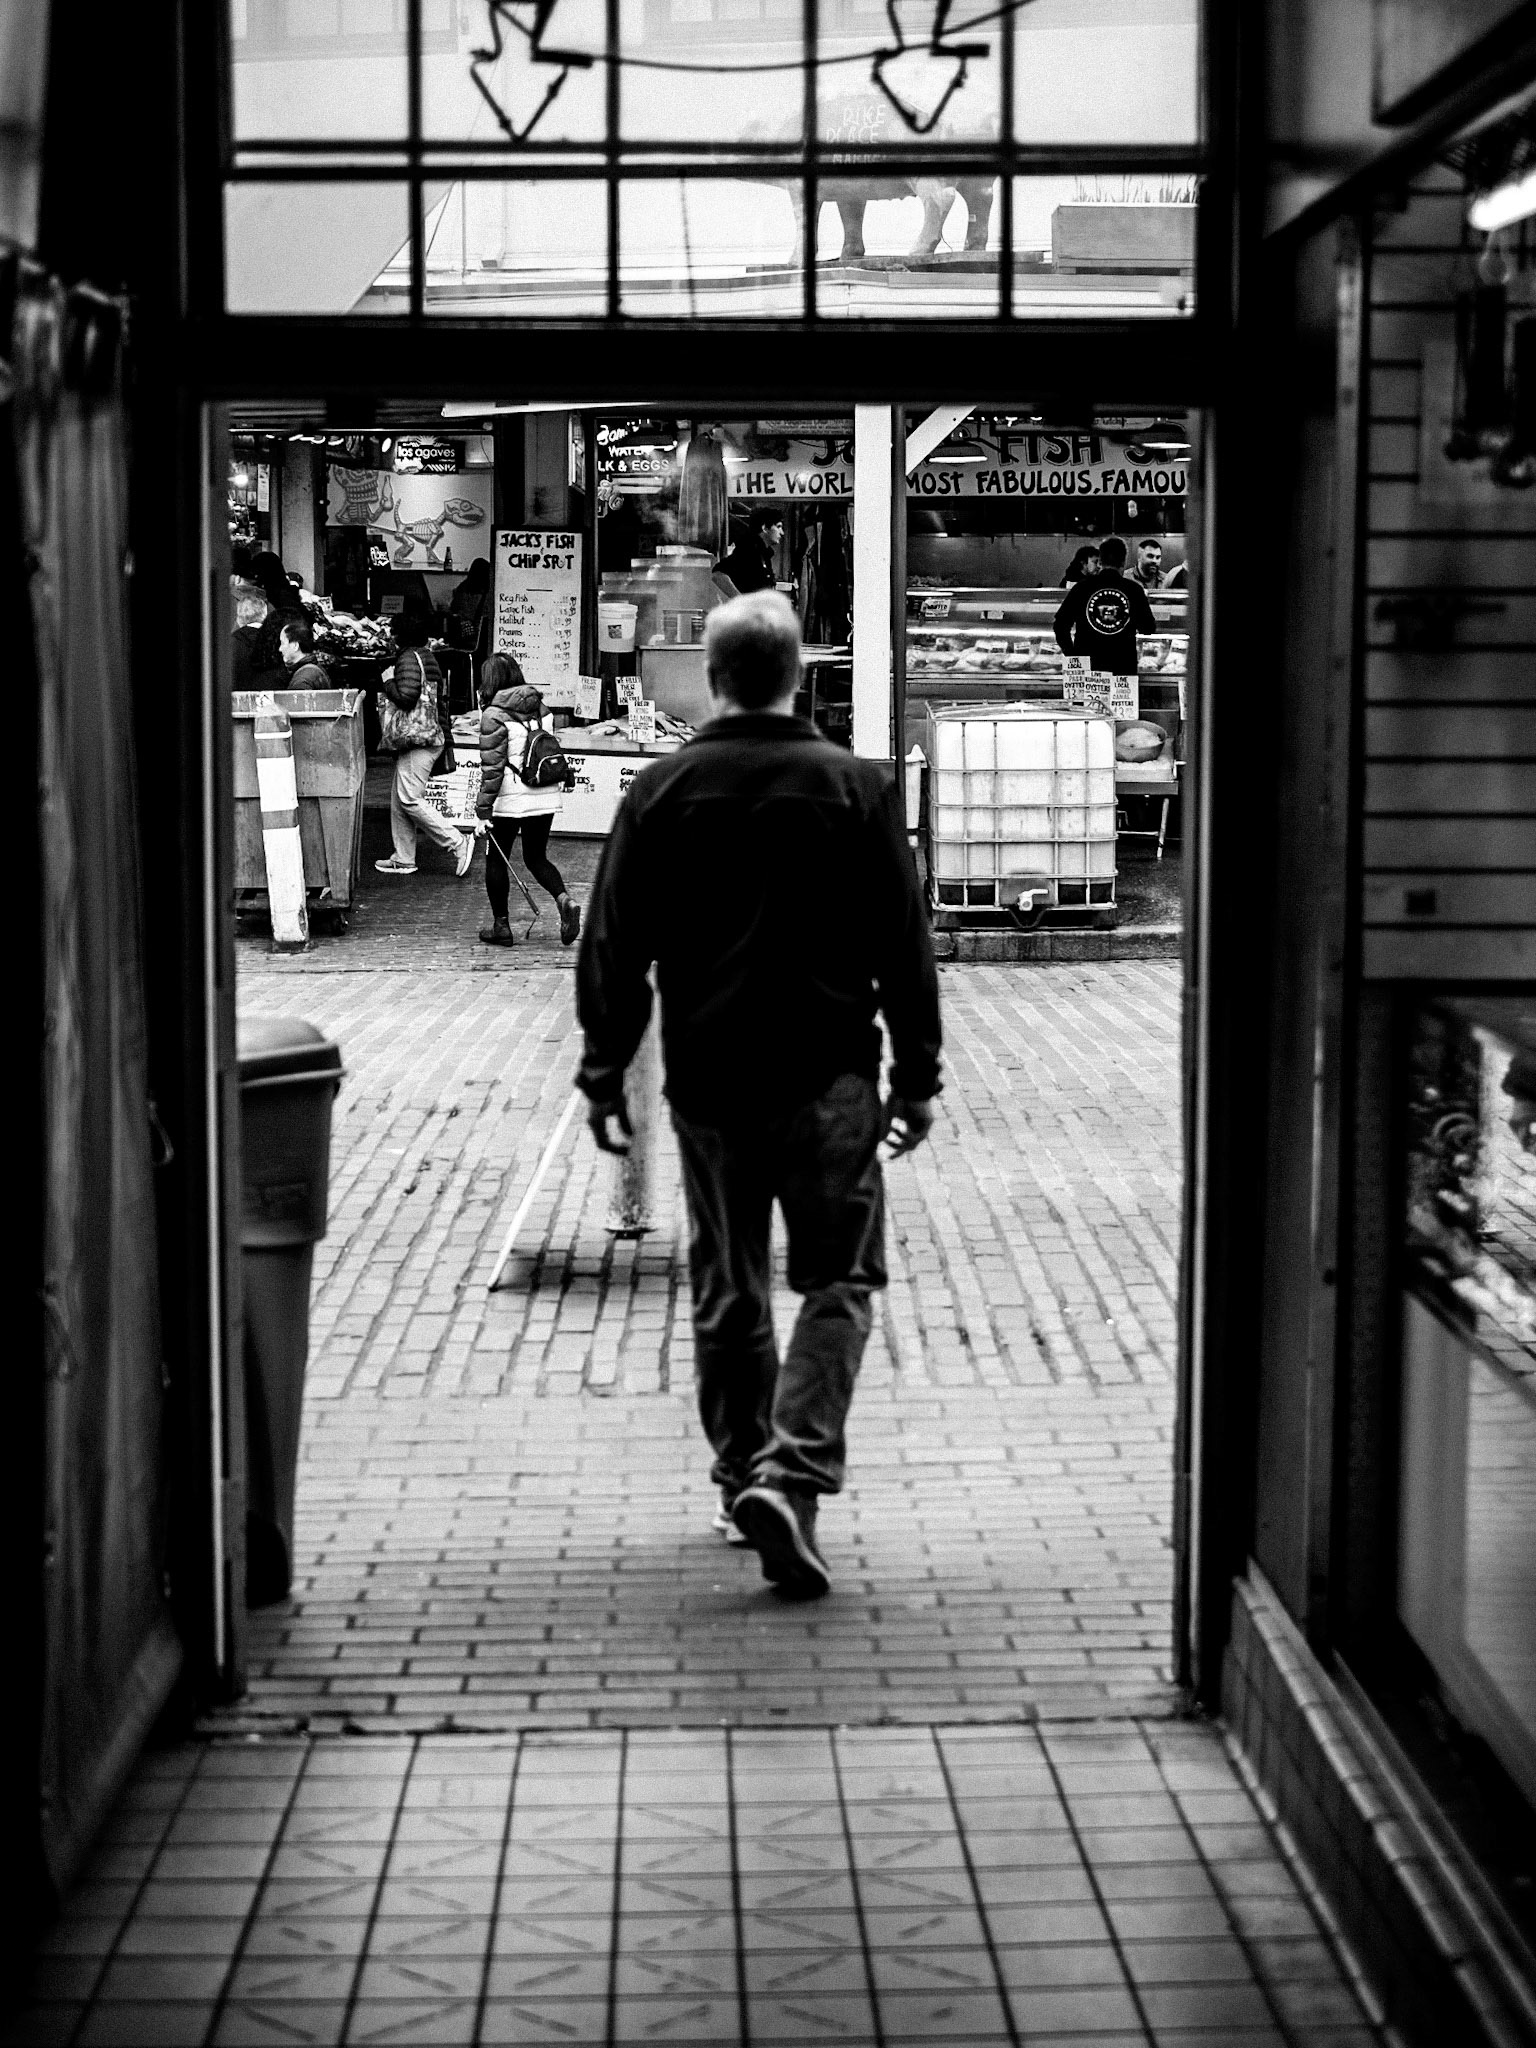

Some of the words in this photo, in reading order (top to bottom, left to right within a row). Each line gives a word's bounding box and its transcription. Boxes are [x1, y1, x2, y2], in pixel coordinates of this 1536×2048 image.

[398, 446, 413, 457] los
[414, 448, 455, 459] agaves
[618, 460, 628, 472] &
[631, 459, 669, 471] EGGS
[731, 471, 776, 495] THE
[905, 470, 964, 495] MOST
[499, 615, 525, 625] Halibut
[498, 638, 526, 650] Oysters
